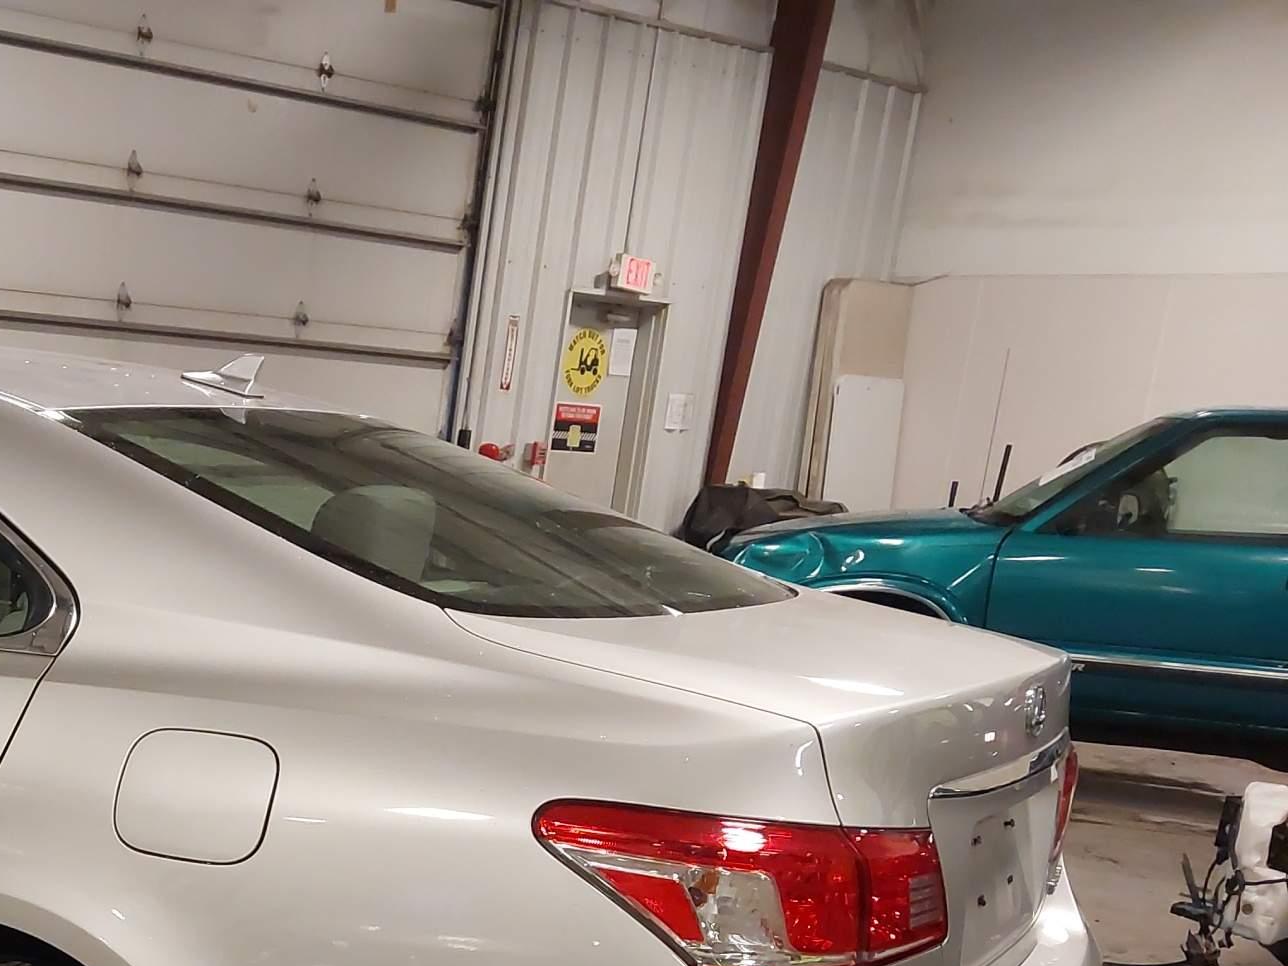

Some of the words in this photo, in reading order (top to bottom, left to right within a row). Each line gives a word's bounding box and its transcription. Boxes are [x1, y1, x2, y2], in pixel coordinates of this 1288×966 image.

[626, 257, 651, 289] EXIT
[568, 330, 587, 352] WATCH
[587, 329, 600, 341] OUT
